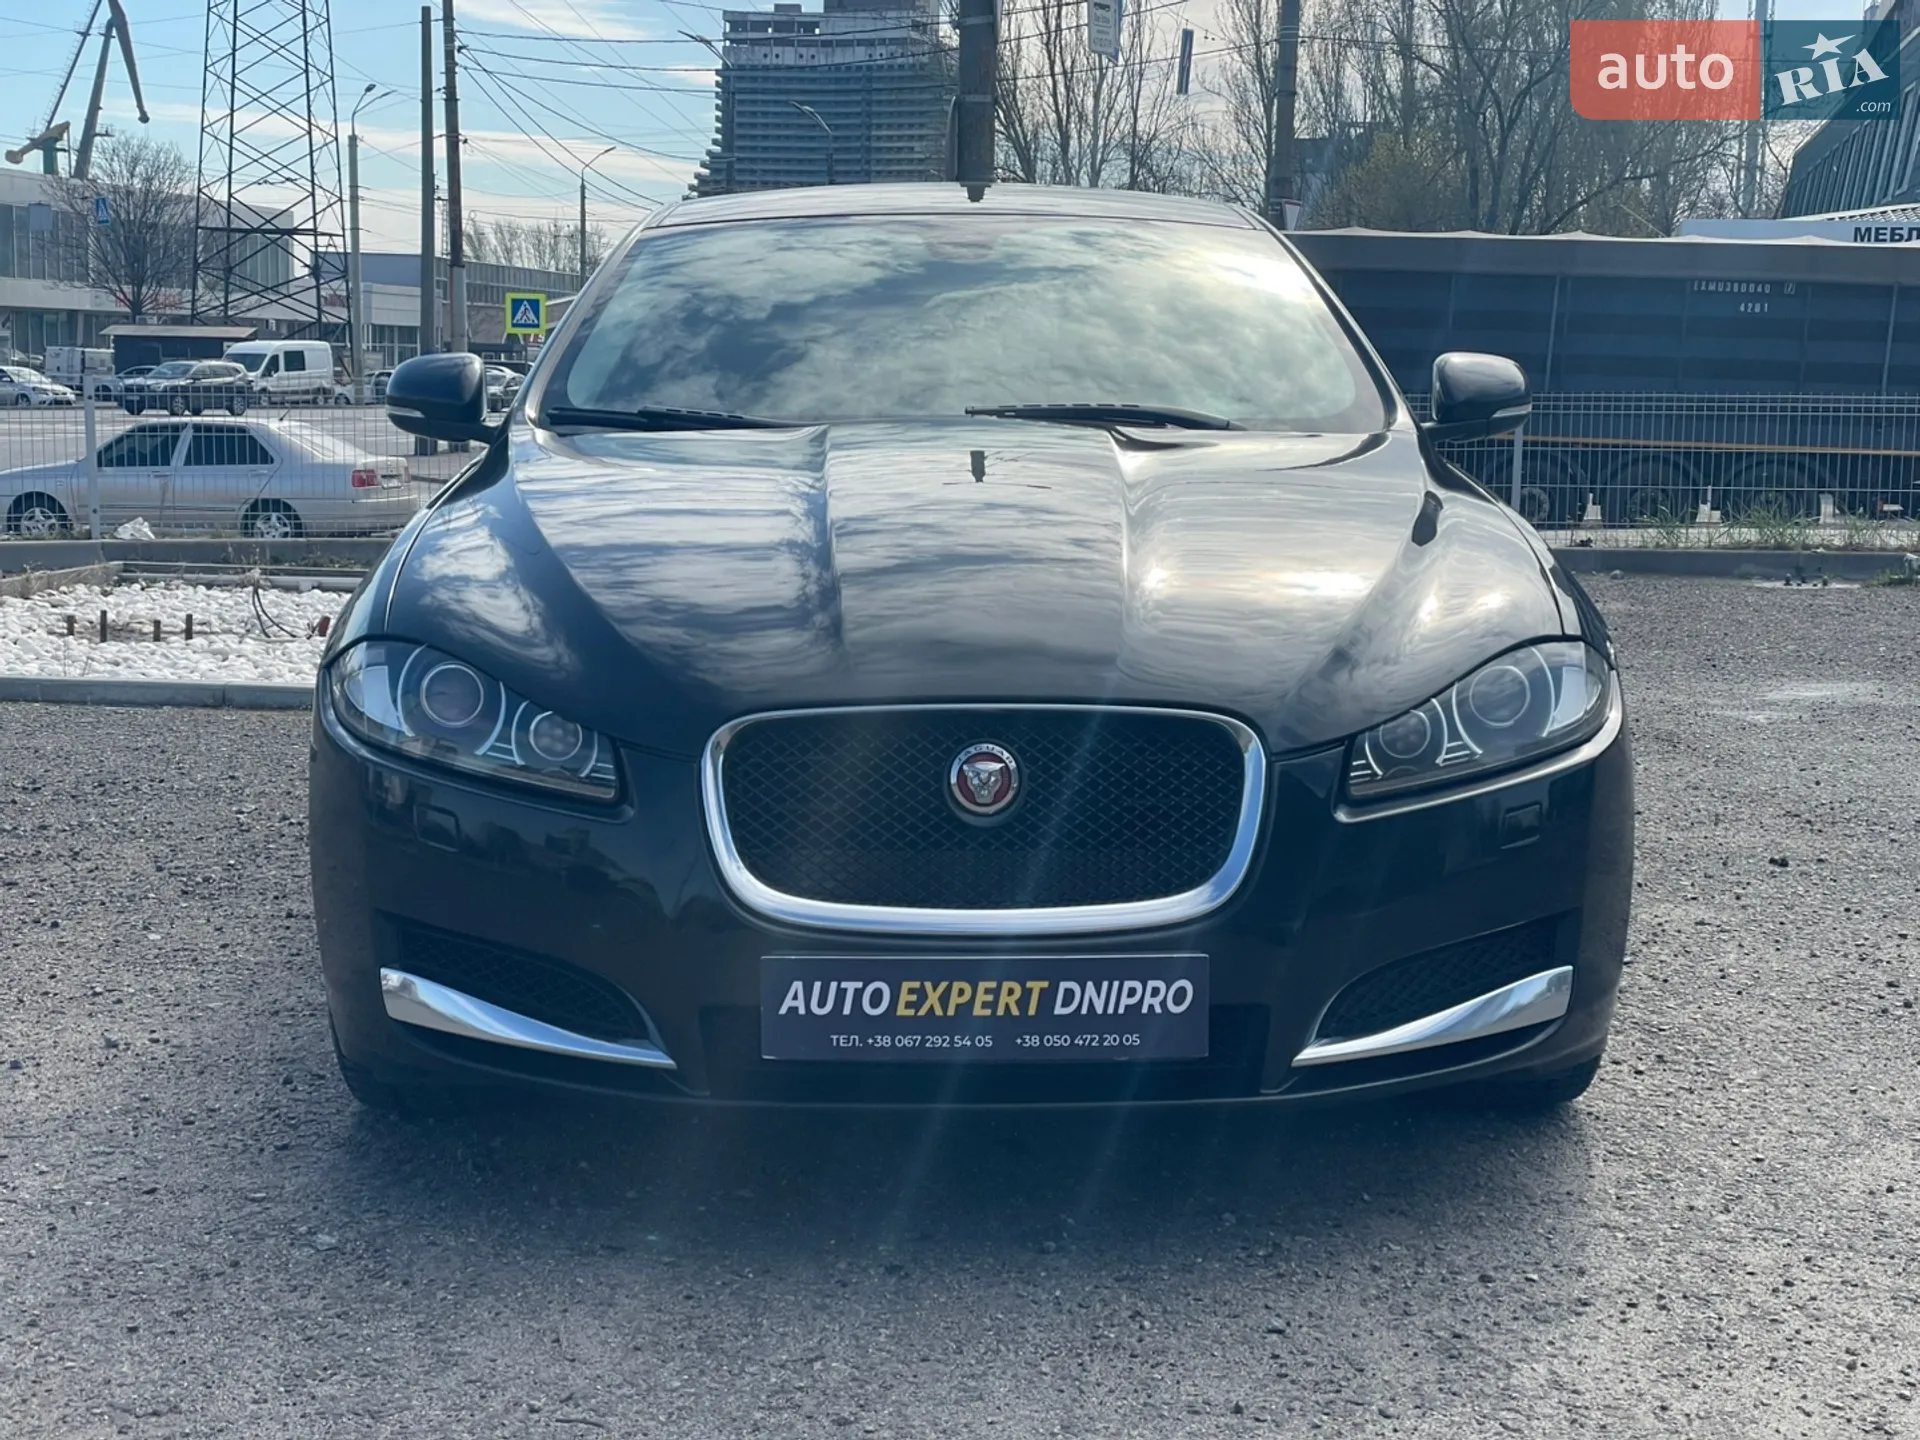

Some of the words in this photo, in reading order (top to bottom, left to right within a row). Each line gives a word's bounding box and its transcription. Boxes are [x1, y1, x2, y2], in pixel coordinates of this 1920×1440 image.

[957, 745, 1014, 765] JAGUAR
[778, 981, 891, 1016] AUTO
[896, 981, 1049, 1016] EXPERT
[1053, 979, 1194, 1015] DNIPRO
[830, 1035, 863, 1047] ТЕЛ.
[866, 1035, 891, 1047] +38
[895, 1035, 921, 1047] 067
[925, 1035, 950, 1047] 292
[953, 1035, 972, 1047] 54
[975, 1035, 993, 1047] 05
[1015, 1035, 1040, 1047] +38
[1043, 1035, 1071, 1047] 050
[1074, 1034, 1099, 1046] 472
[1103, 1034, 1120, 1046] 20
[1123, 1034, 1140, 1046] 05
